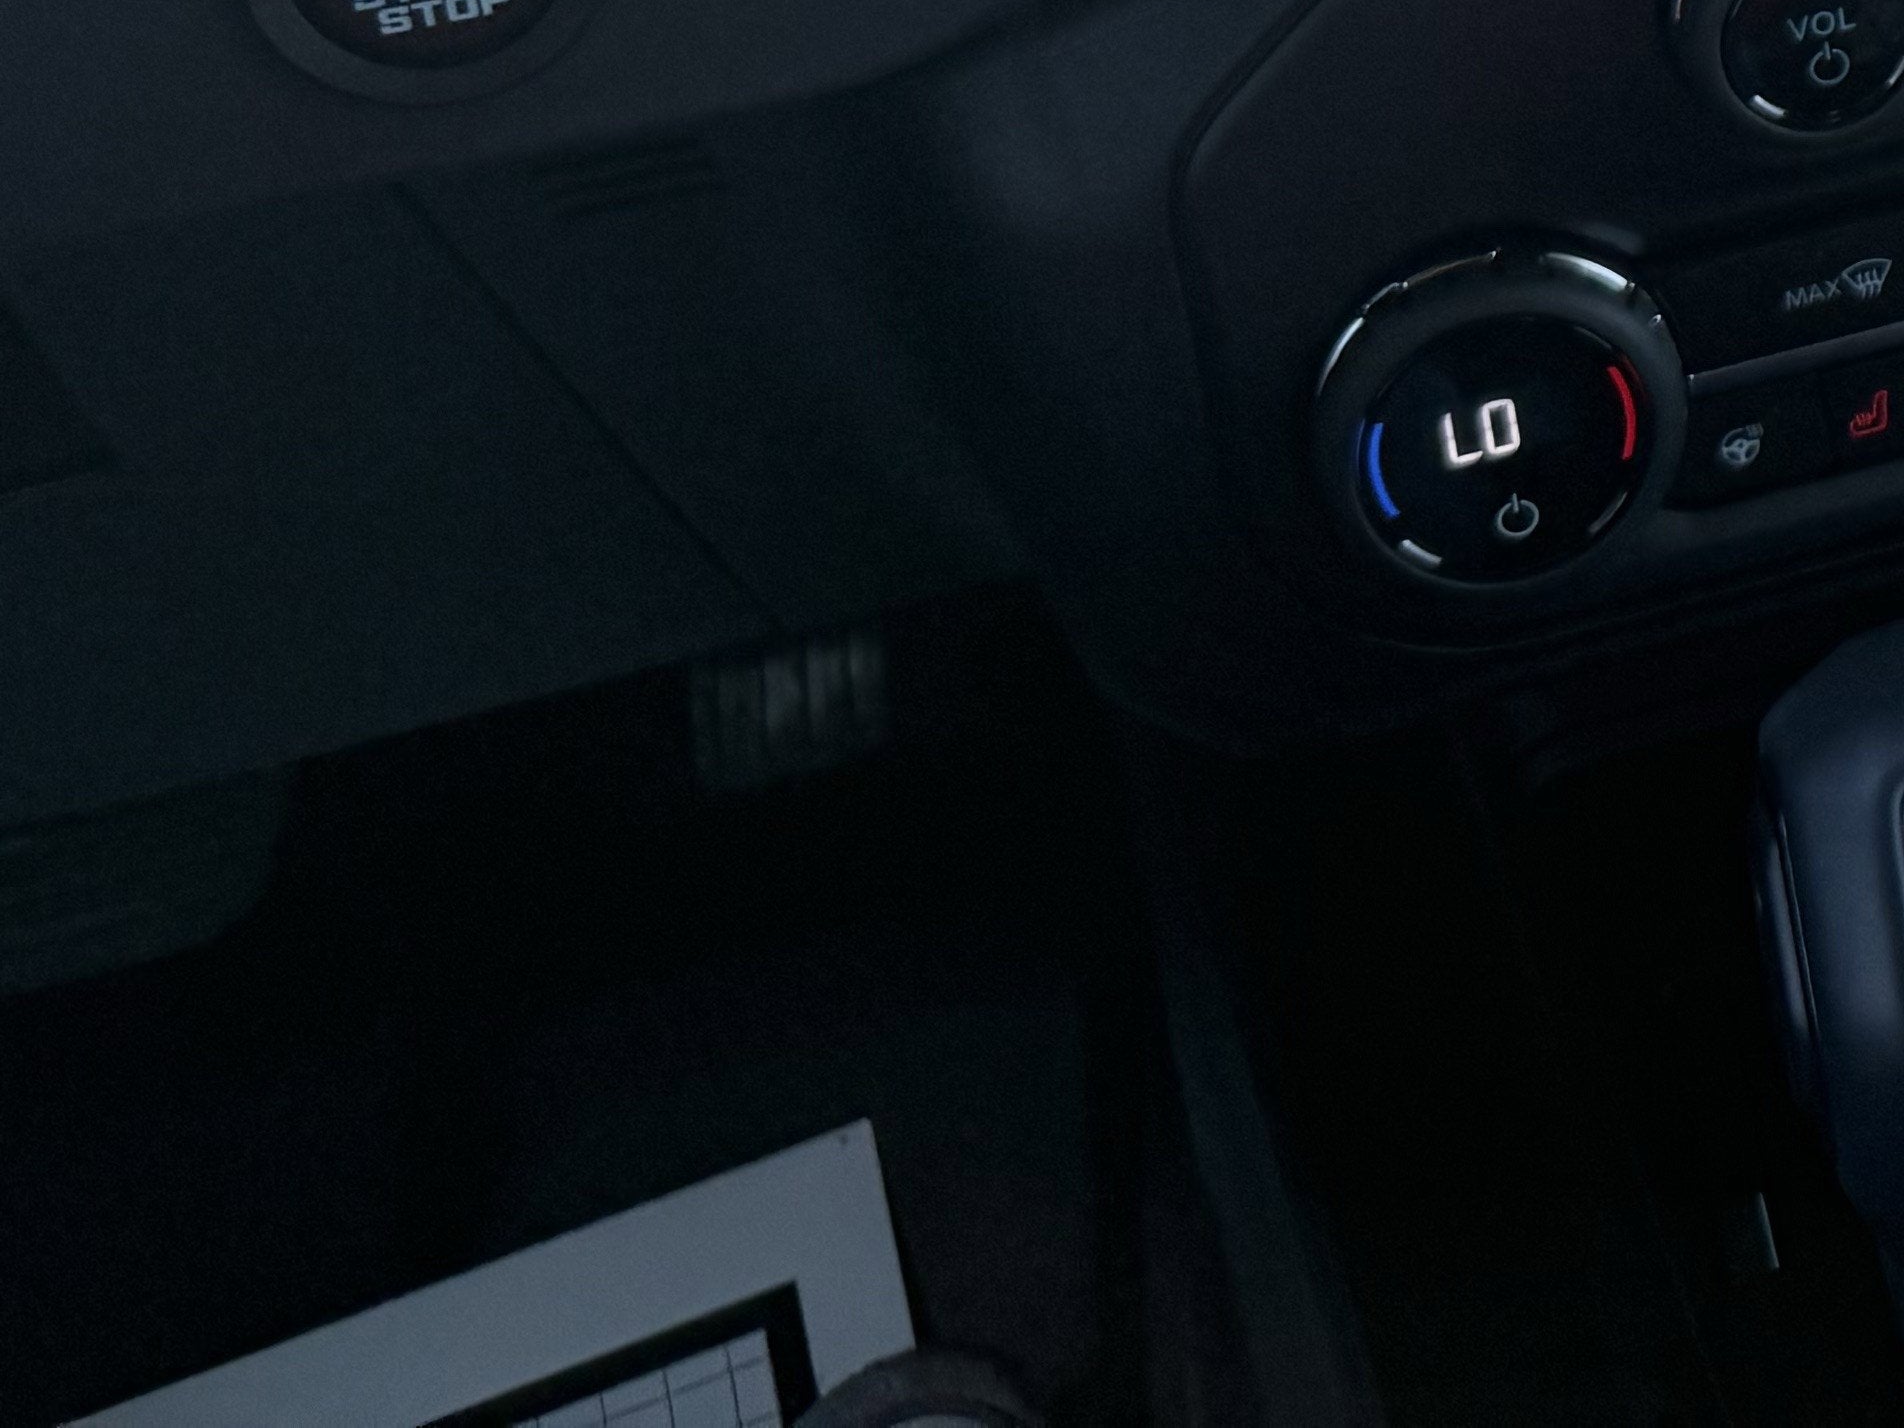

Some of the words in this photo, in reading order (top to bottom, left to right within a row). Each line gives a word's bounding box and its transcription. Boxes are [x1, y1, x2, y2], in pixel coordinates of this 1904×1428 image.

[1788, 8, 1856, 42] VOL
[1785, 280, 1840, 309] MAX
[1442, 399, 1520, 466] LO
